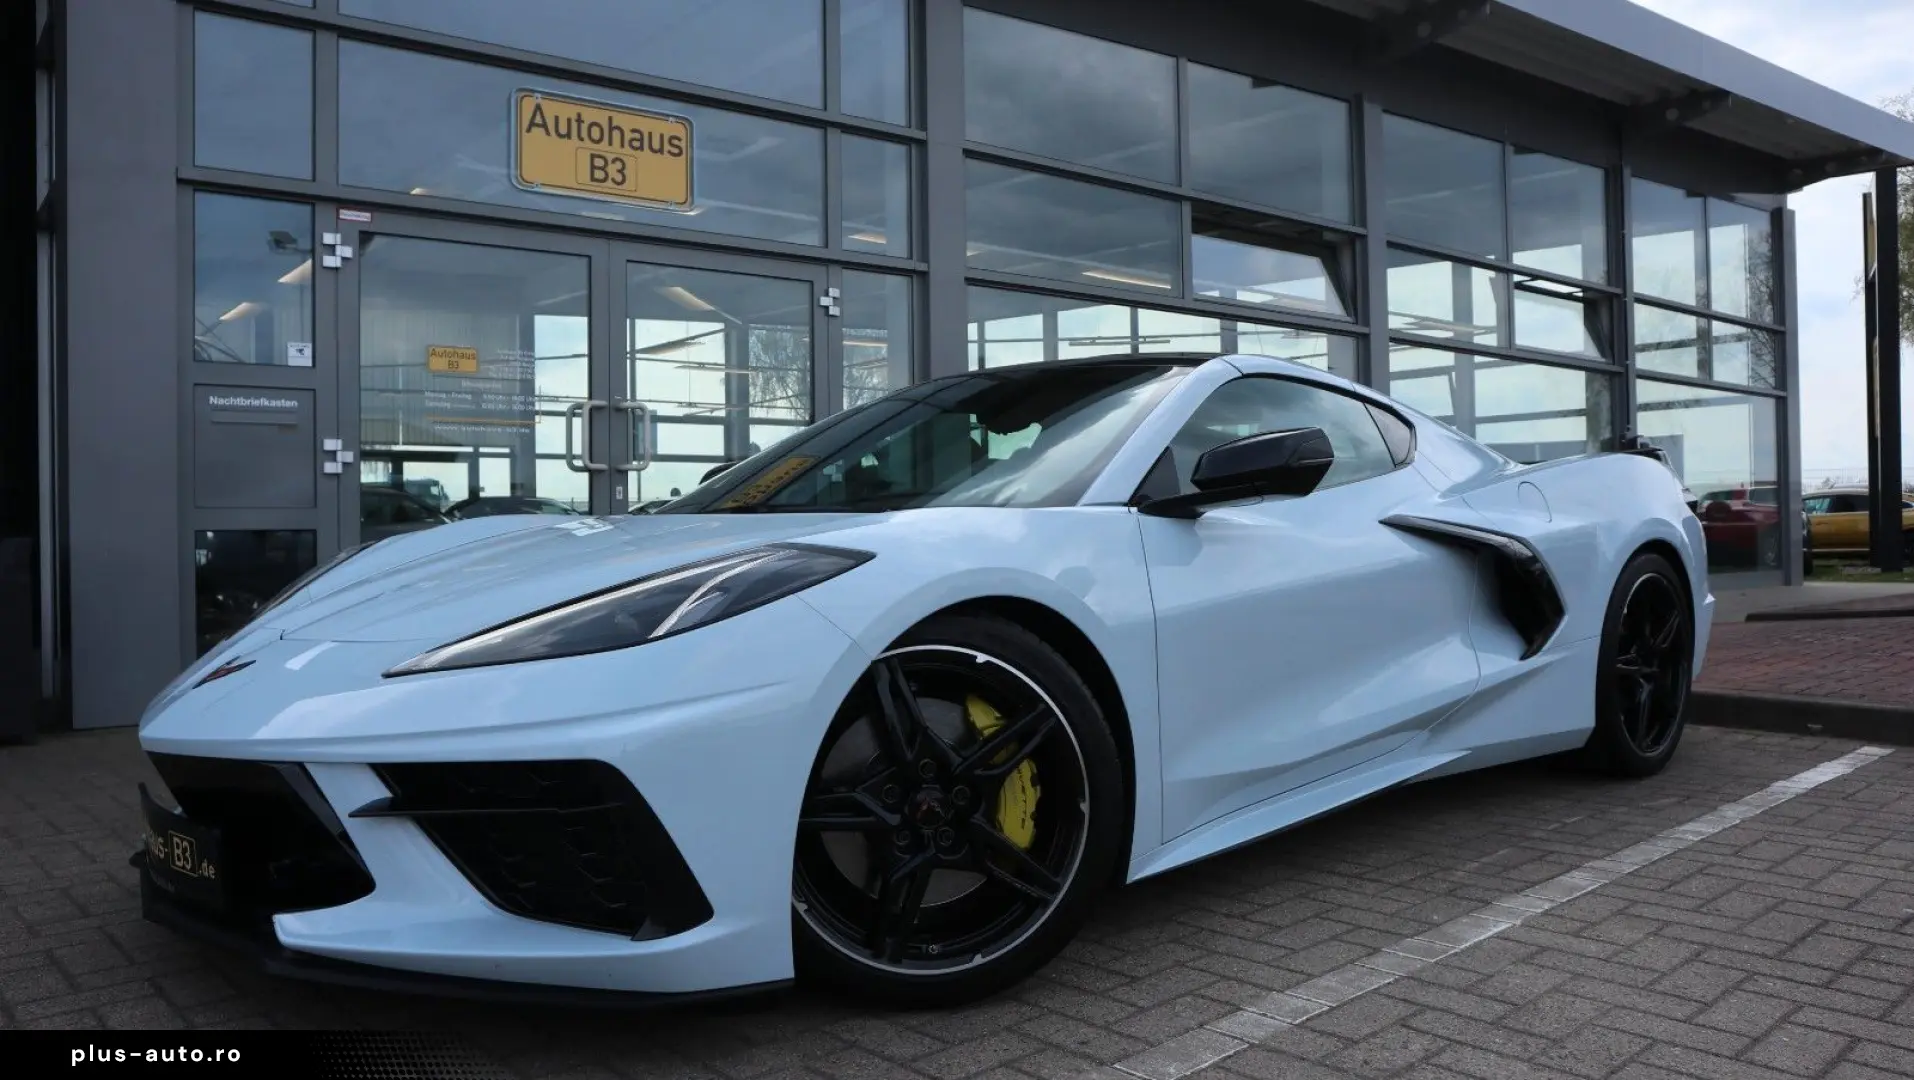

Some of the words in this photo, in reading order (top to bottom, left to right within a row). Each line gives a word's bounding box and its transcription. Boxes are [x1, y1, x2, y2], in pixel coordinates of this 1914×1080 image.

[525, 103, 684, 158] Autohaus
[588, 153, 627, 186] B3
[430, 347, 477, 360] Autohaus
[447, 359, 460, 370] B3
[208, 395, 298, 409] Nachtbriefkasten
[172, 836, 192, 870] B3
[199, 859, 216, 879] .de
